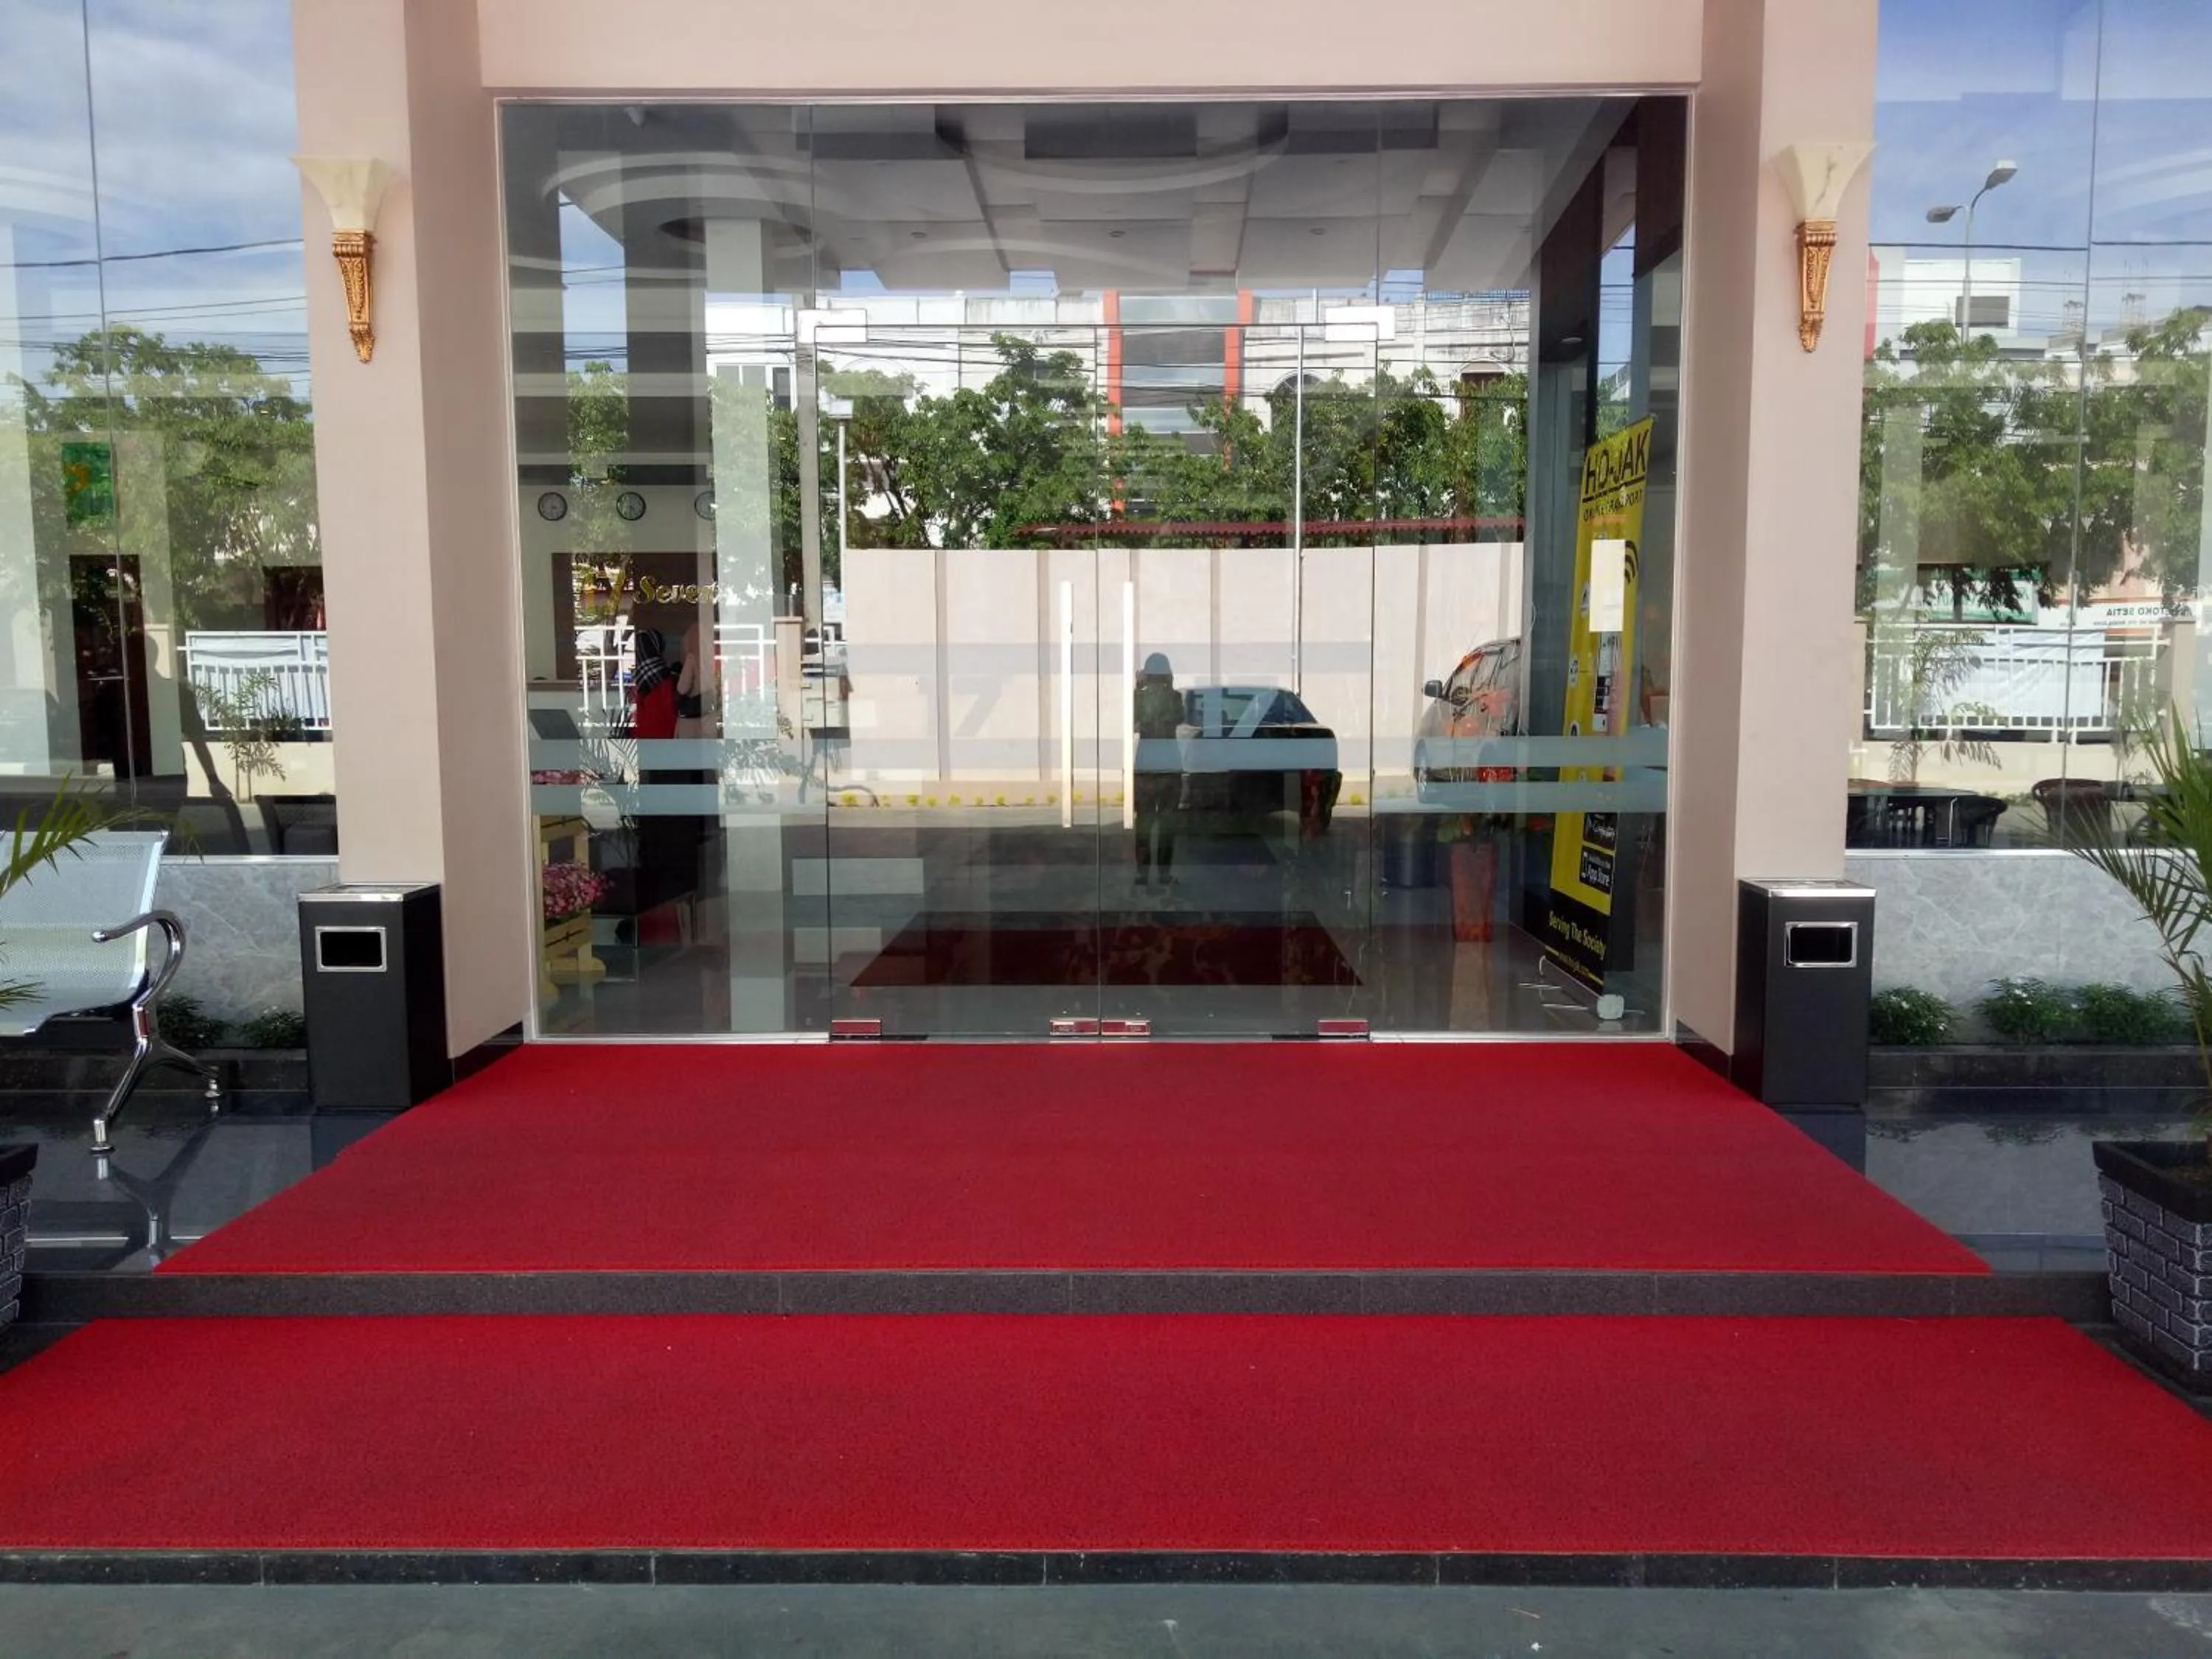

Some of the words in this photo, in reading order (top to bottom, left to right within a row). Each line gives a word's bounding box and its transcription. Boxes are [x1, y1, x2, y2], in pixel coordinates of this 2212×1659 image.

[1194, 676, 1279, 737] 17
[1548, 910, 1571, 940] Serving
[1571, 922, 1582, 944] The
